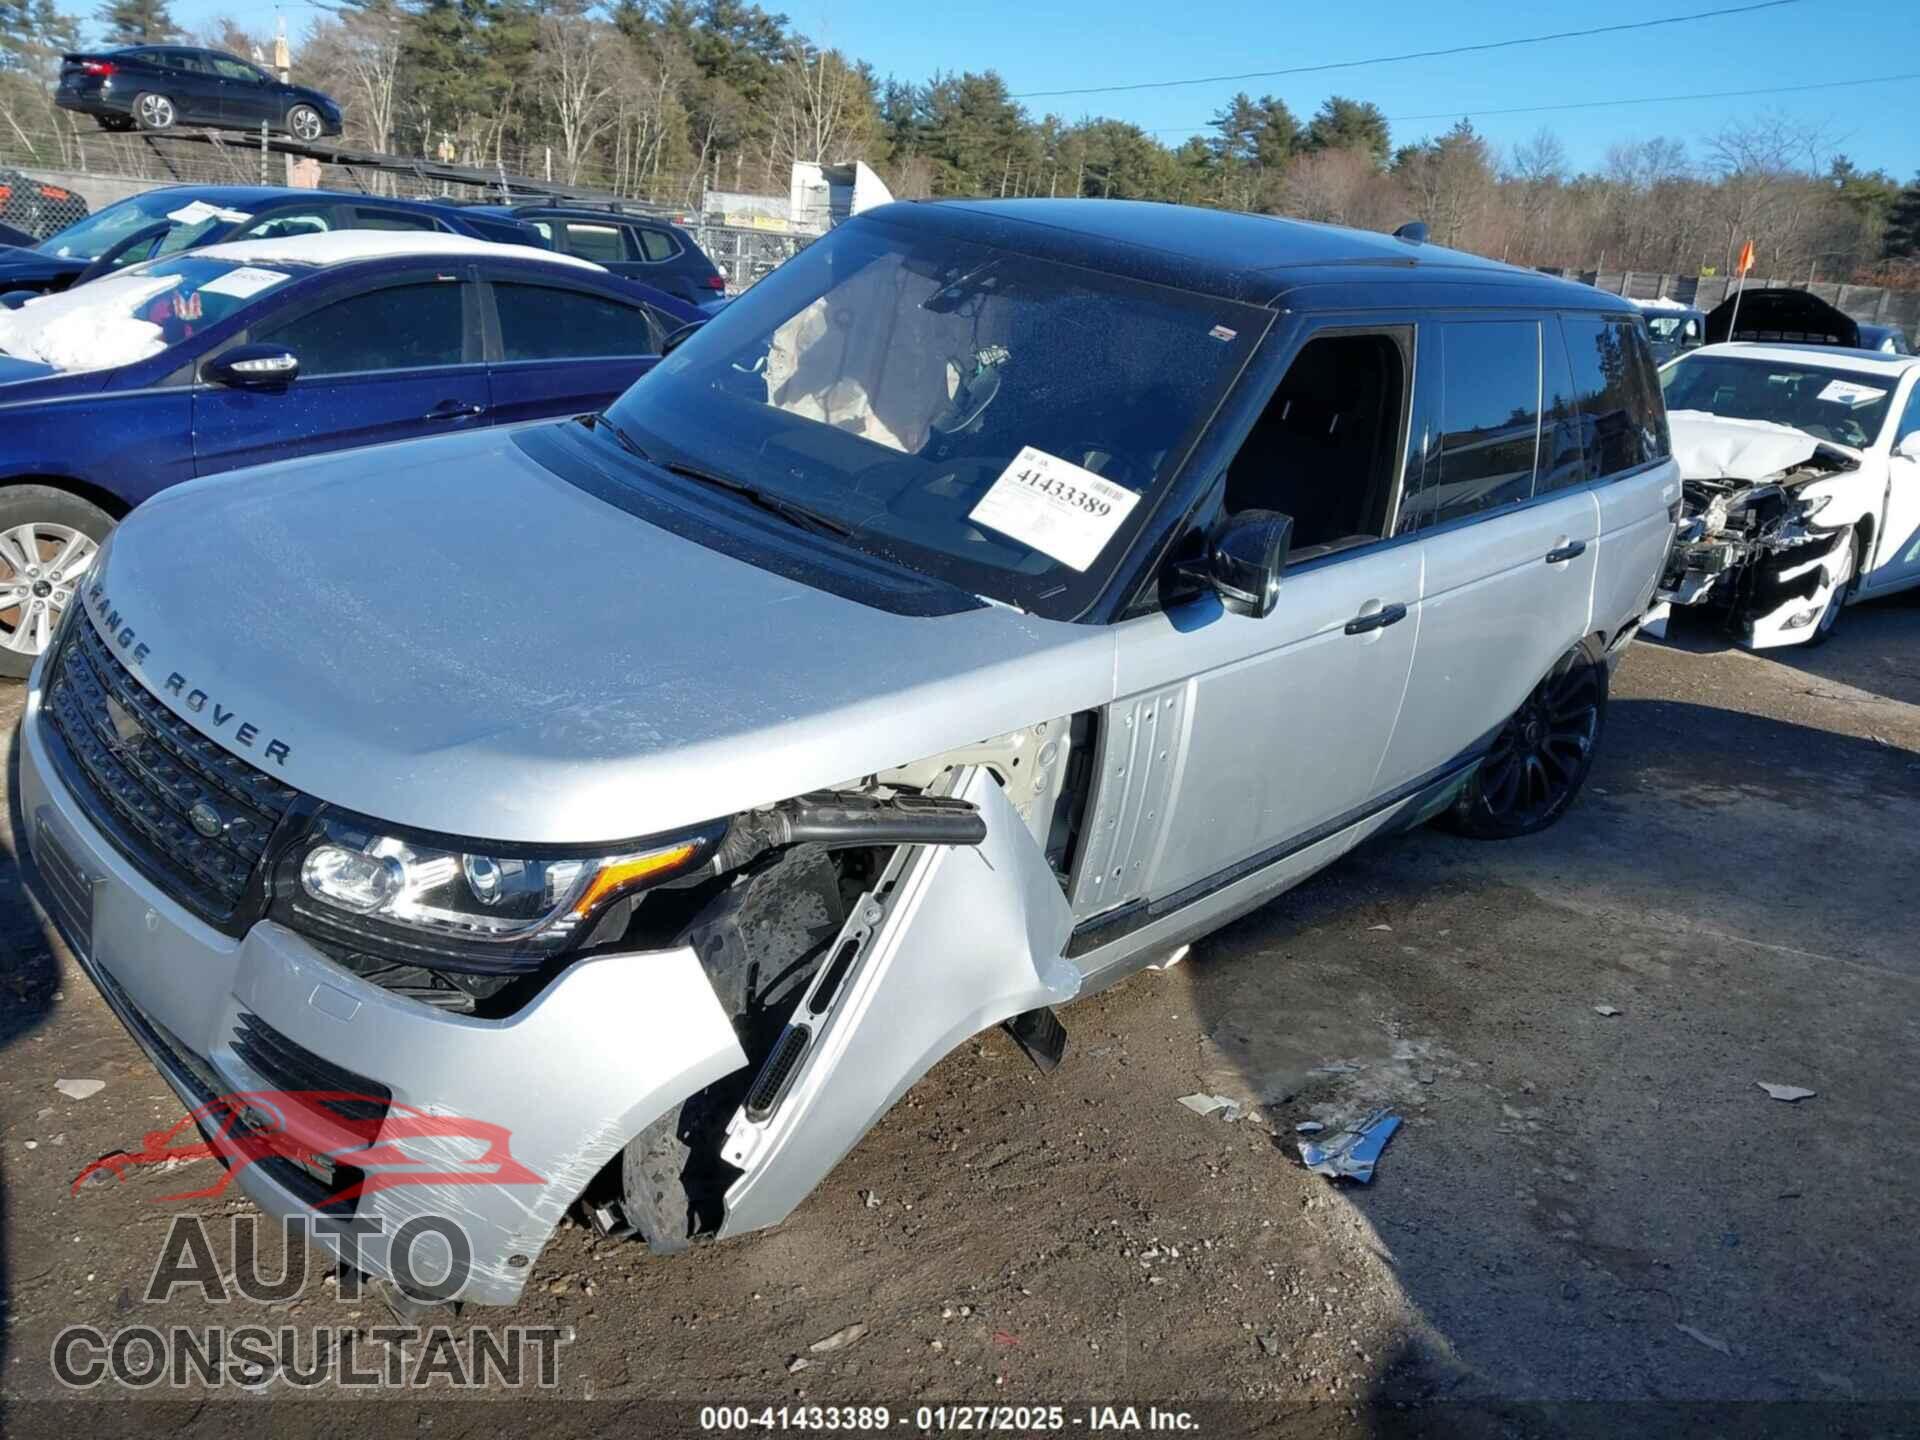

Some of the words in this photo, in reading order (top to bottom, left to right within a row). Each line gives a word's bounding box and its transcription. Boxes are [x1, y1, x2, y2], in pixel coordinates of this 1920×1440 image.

[1016, 469, 1112, 517] 41433389
[88, 584, 151, 665] RANGE
[164, 671, 291, 766] ROVER
